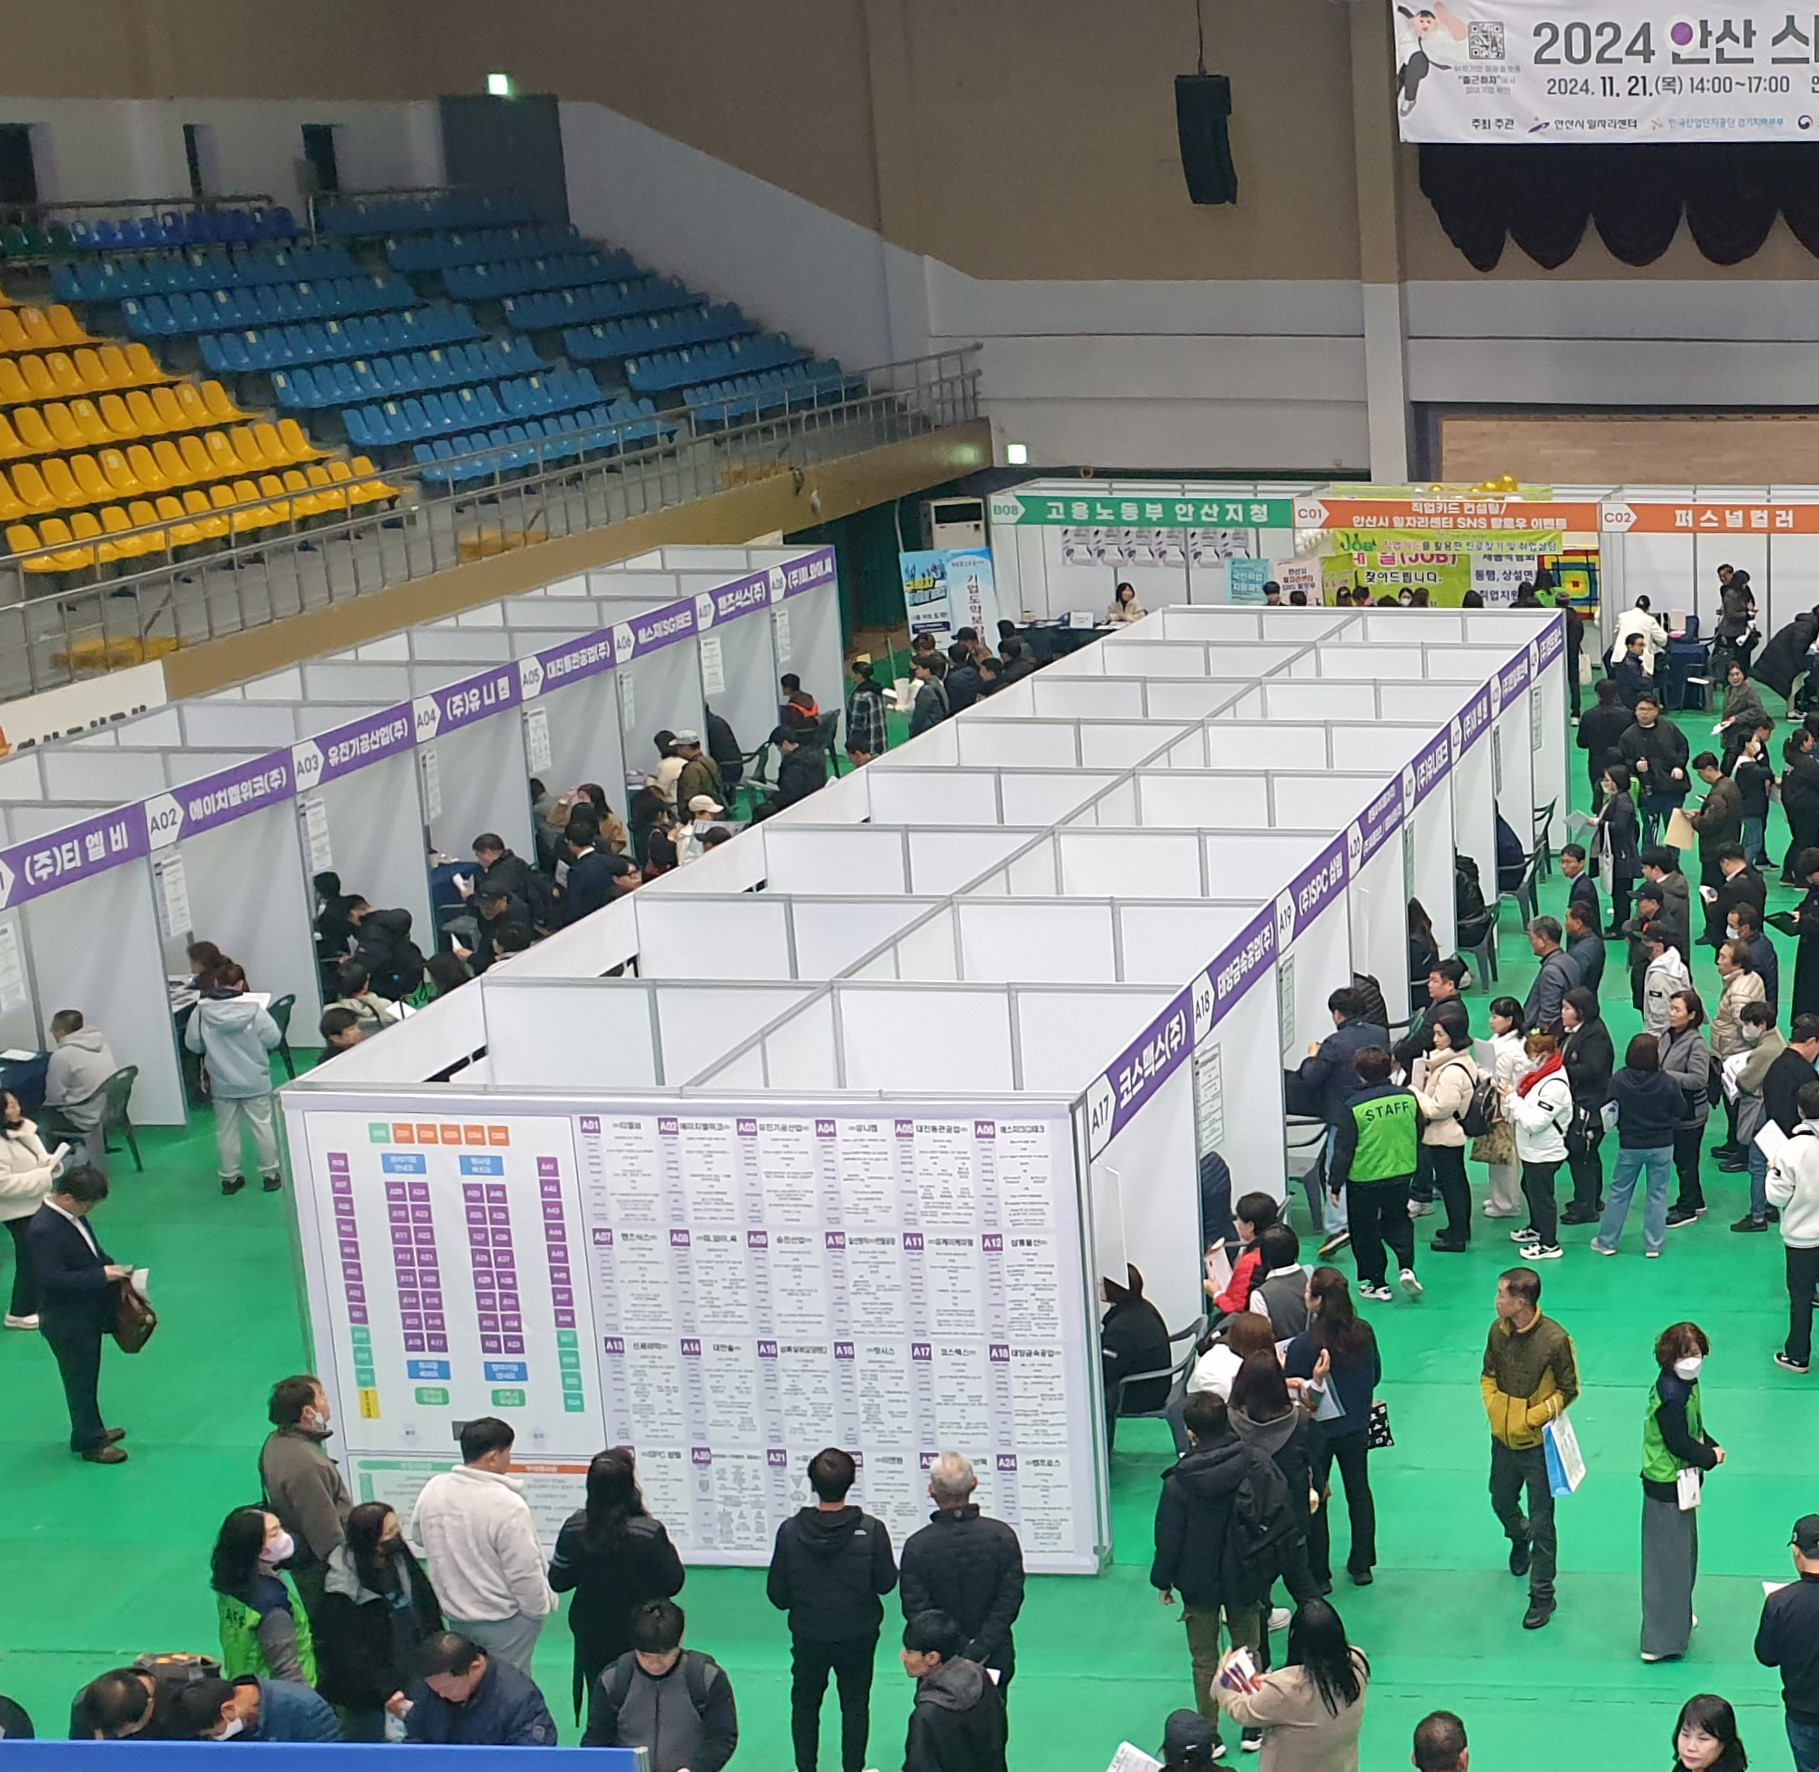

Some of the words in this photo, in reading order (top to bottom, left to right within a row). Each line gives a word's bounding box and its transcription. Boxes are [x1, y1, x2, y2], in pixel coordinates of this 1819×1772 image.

[1532, 21, 1656, 66] 2024
[1667, 17, 1757, 66] 안산
[1546, 77, 1596, 96] 2024.
[1600, 76, 1621, 97] 11.
[1688, 75, 1791, 95] 14:00~17:00
[1472, 119, 1491, 130] 주최
[1495, 119, 1515, 130] 주관
[993, 505, 1019, 516] B08
[1175, 502, 1269, 523] 안산지청
[1298, 508, 1323, 519] C01
[1410, 501, 1461, 514] 직업카드
[1605, 512, 1631, 523] C02
[1352, 516, 1390, 529] 안산시
[1392, 516, 1454, 529] 일자리센터
[1457, 517, 1488, 529] SNS
[1502, 570, 1536, 582] 상설면
[616, 635, 632, 651] A06
[522, 667, 540, 687] A05
[416, 707, 437, 731] A04
[296, 754, 320, 777] A03
[150, 811, 179, 837] A02
[1279, 904, 1292, 934] A19
[1195, 990, 1210, 1023] A18
[1119, 1009, 1188, 1110] 코스맥스(주)
[1091, 1094, 1110, 1136] A17
[1365, 1100, 1410, 1122] STAFF
[905, 1236, 923, 1248] A11
[913, 1345, 931, 1357] A17
